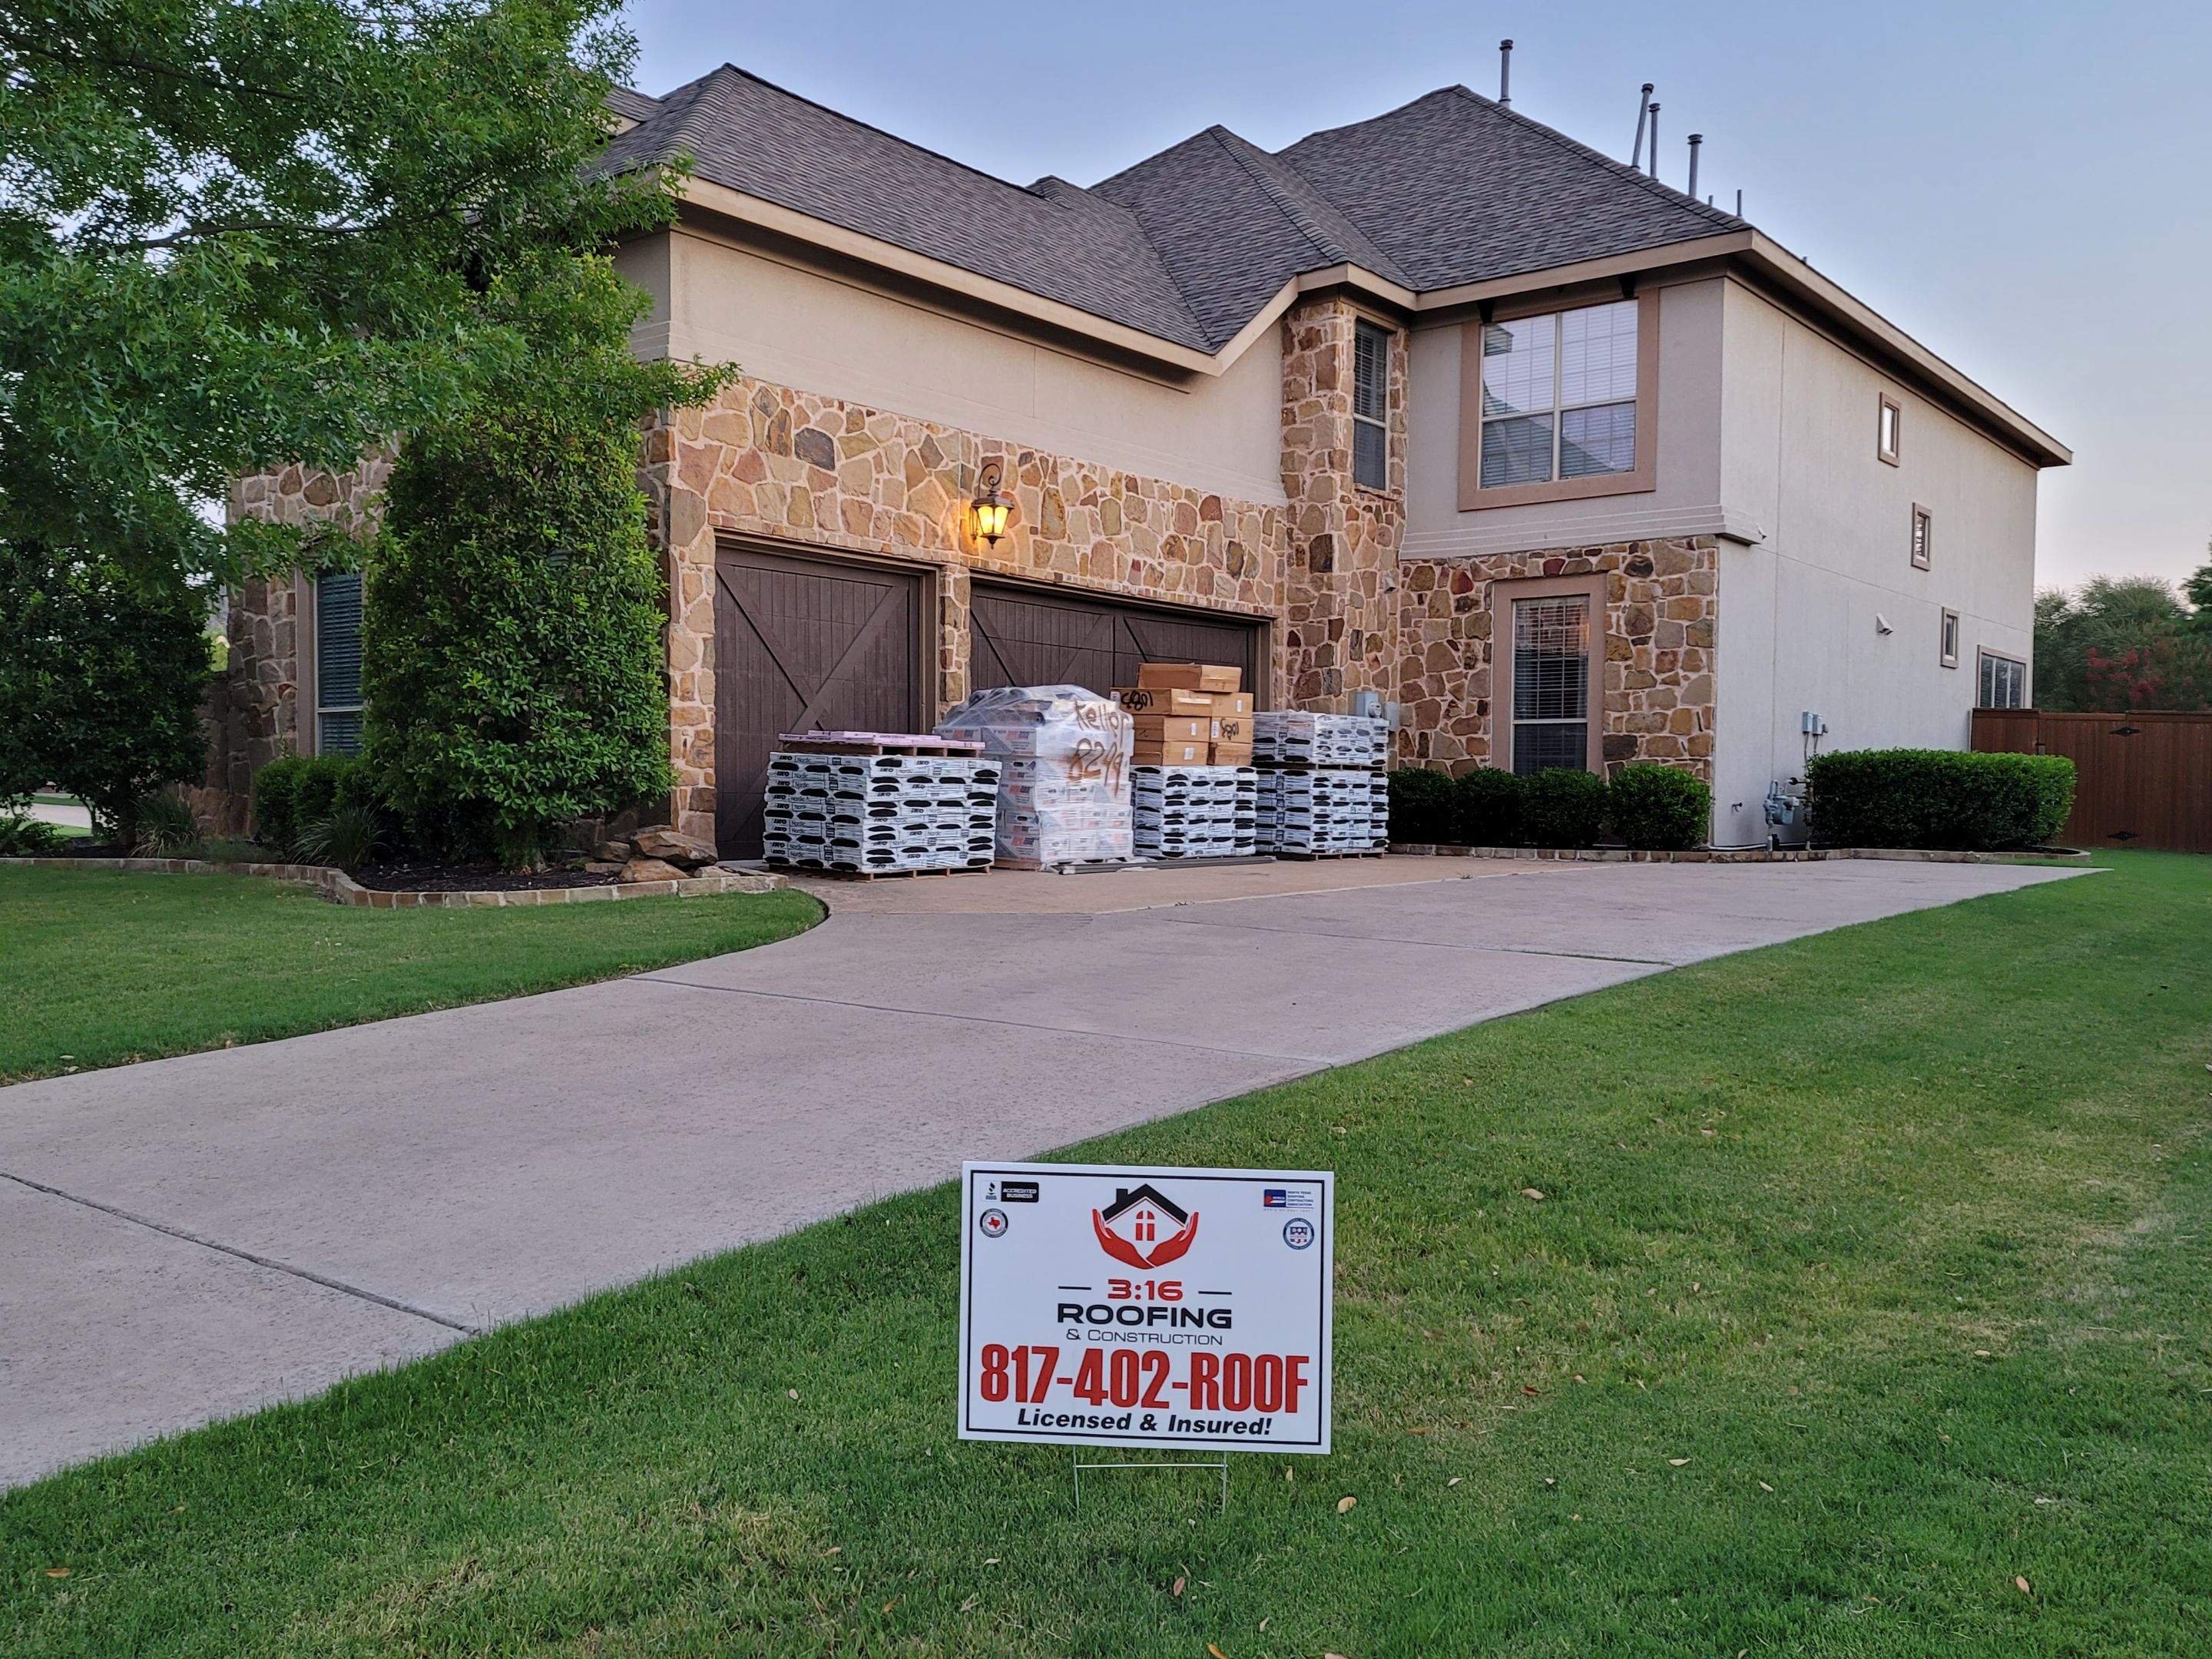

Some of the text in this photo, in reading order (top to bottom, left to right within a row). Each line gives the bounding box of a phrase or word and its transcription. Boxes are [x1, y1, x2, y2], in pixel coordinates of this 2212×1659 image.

[1108, 1278, 1184, 1302] 3:16
[1057, 1303, 1232, 1330] ROOFING
[1066, 1328, 1224, 1346] & CONSTRUCTION
[980, 1343, 1310, 1414] 817-402-ROOF
[1018, 1408, 1273, 1435] Licensed & Insured!
